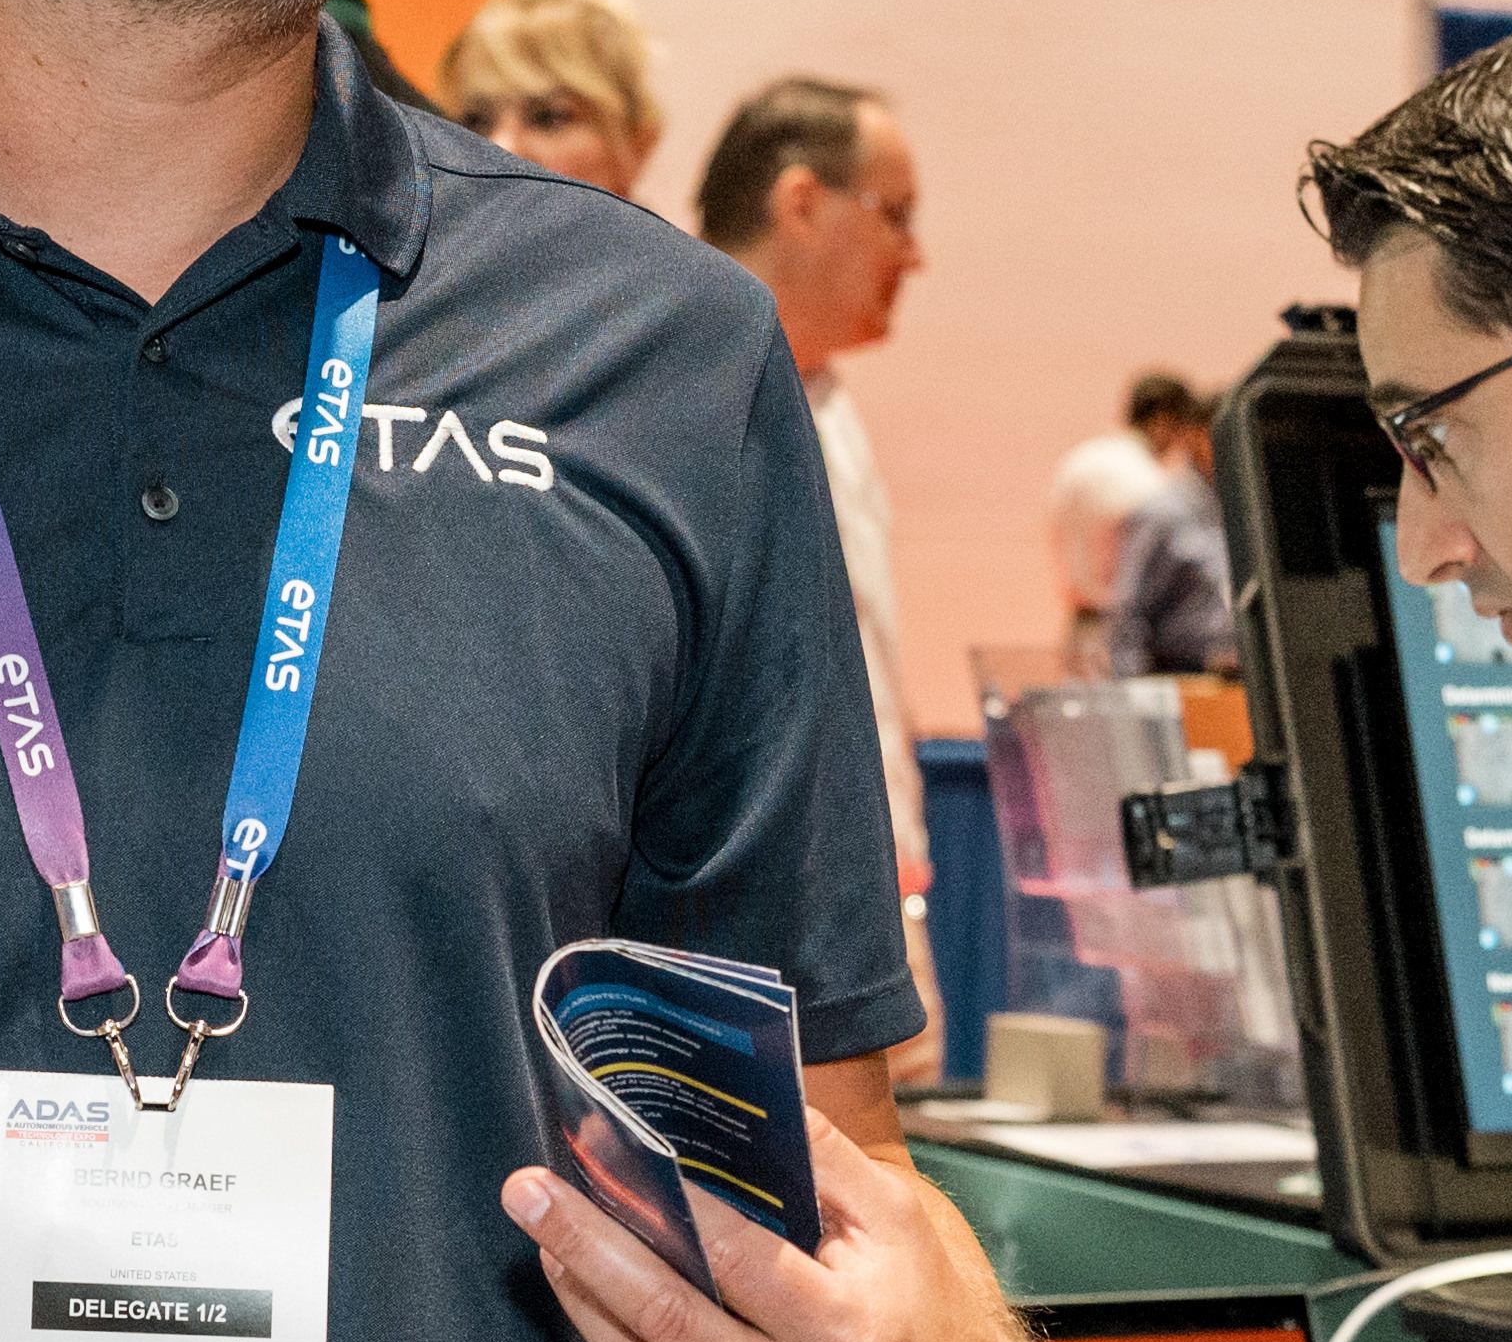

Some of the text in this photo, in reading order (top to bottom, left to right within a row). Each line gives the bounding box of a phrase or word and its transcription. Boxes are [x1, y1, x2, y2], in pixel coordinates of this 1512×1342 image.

[7, 1099, 110, 1122] ADAS
[14, 1122, 73, 1131] AUTONOMOUS
[74, 1168, 237, 1192] BERND GRAEF
[131, 1231, 179, 1248] ETAS
[110, 1269, 197, 1282] UNITED STATES
[68, 1297, 227, 1324] DELEGATE 1/2
